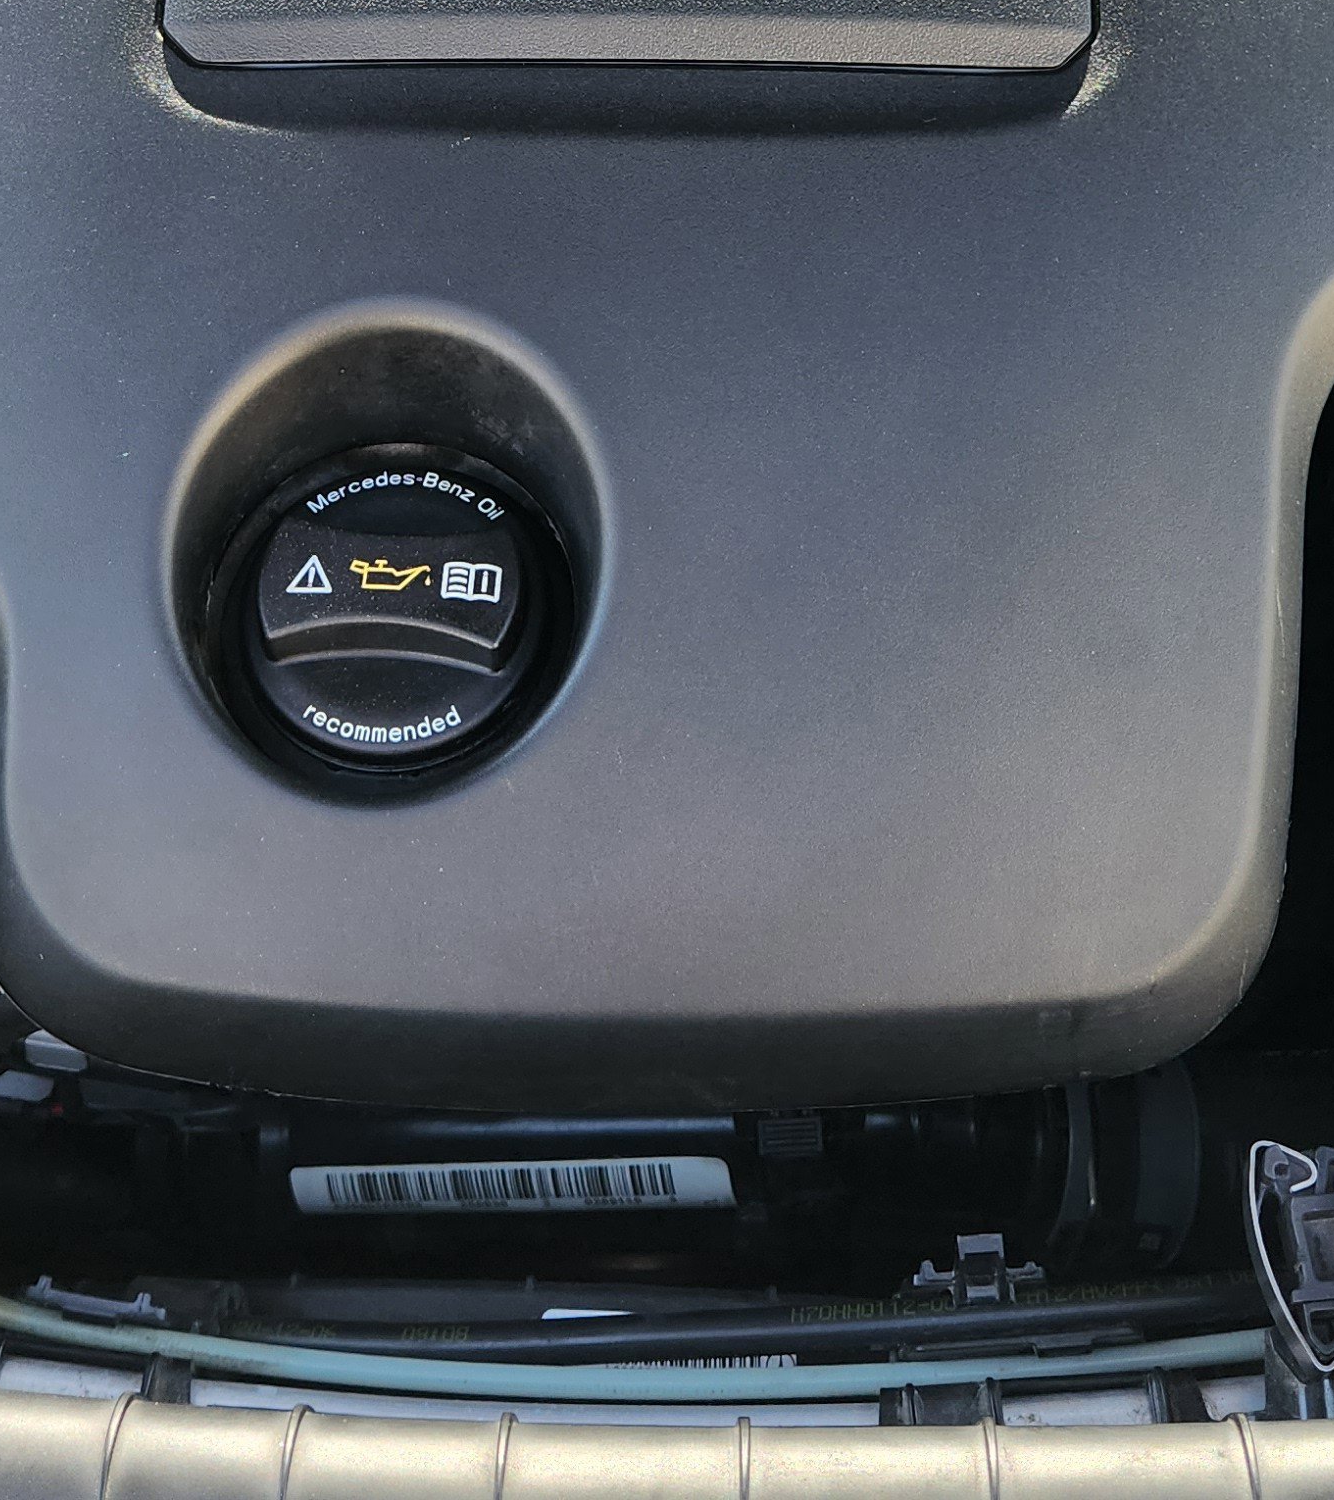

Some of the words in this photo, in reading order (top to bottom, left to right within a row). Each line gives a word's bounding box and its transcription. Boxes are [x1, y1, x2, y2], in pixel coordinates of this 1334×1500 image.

[306, 470, 476, 515] Mercedes-Benz
[477, 496, 505, 522] Oil
[302, 704, 462, 744] recommended
